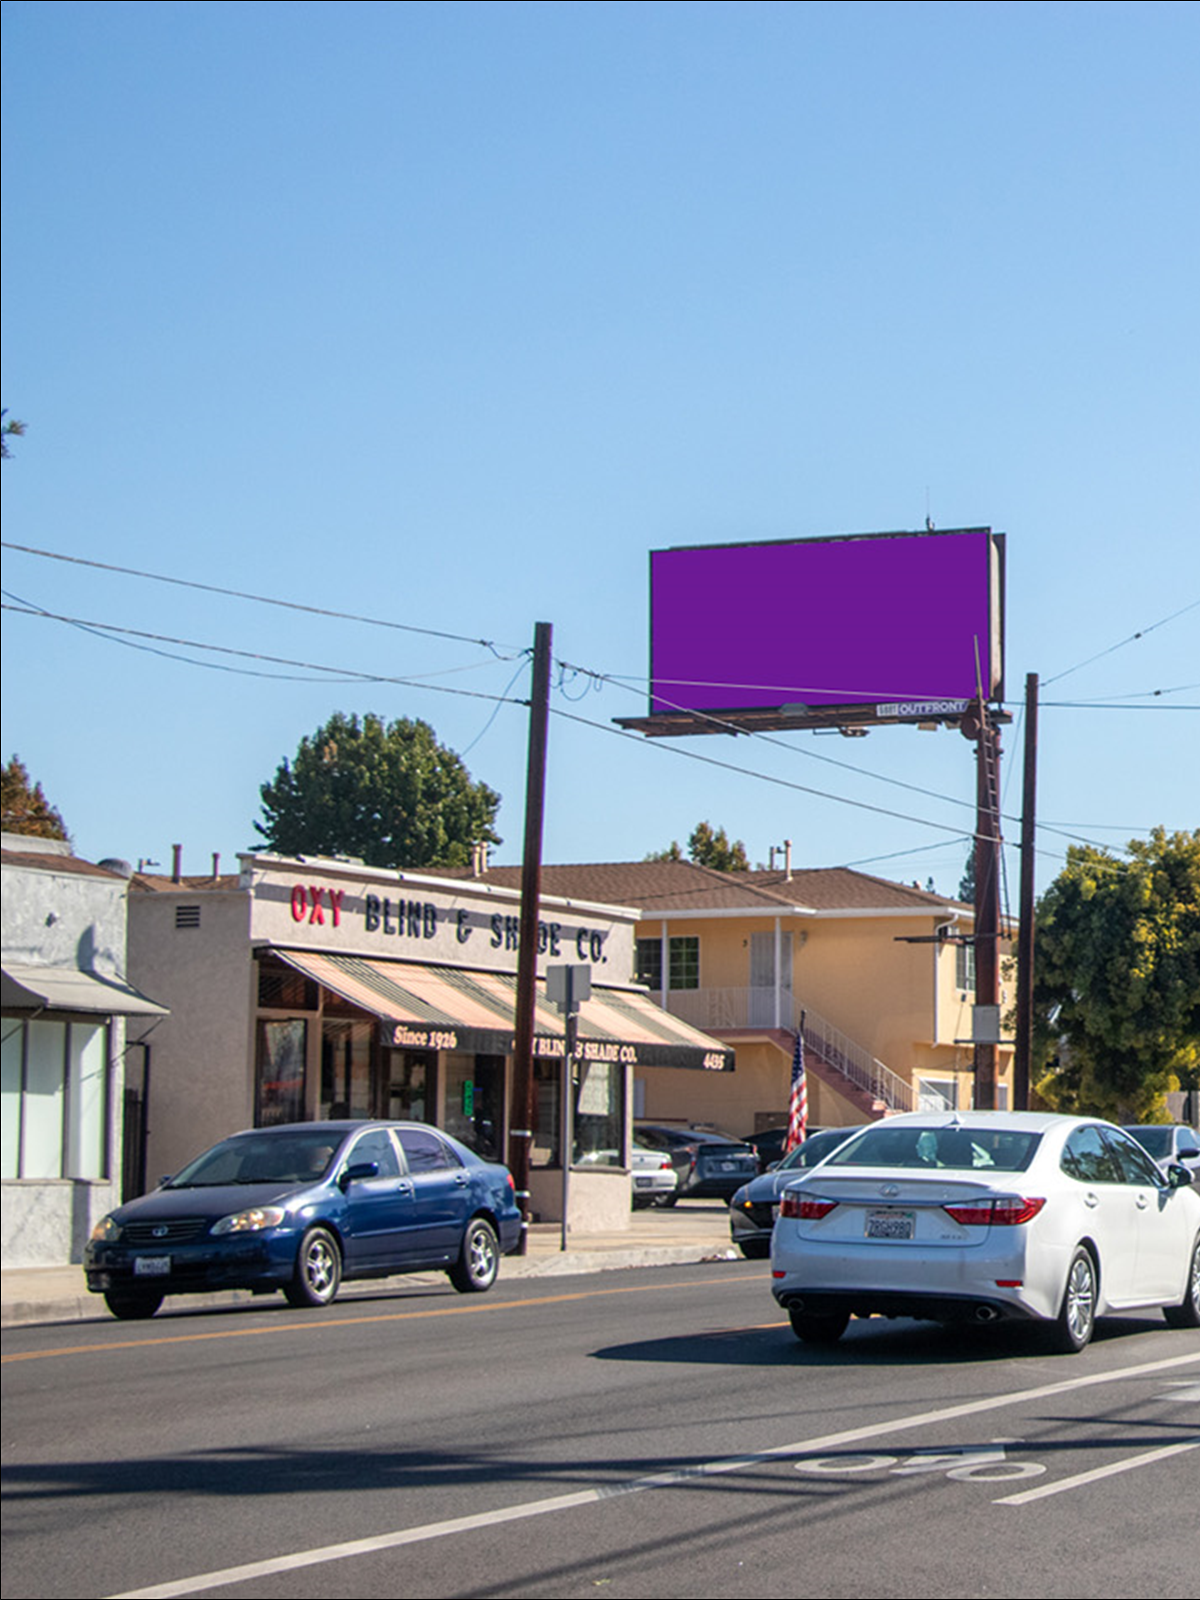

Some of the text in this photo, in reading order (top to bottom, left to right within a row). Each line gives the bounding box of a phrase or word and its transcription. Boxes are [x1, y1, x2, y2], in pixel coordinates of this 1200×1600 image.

[899, 701, 967, 714] OUTFRONT
[290, 884, 608, 964] OXY BLIND & SHDE CO.
[393, 1025, 458, 1049] Since 1926
[538, 1037, 567, 1057] BLIN
[584, 1042, 620, 1062] SHADE
[620, 1045, 638, 1063] CO.
